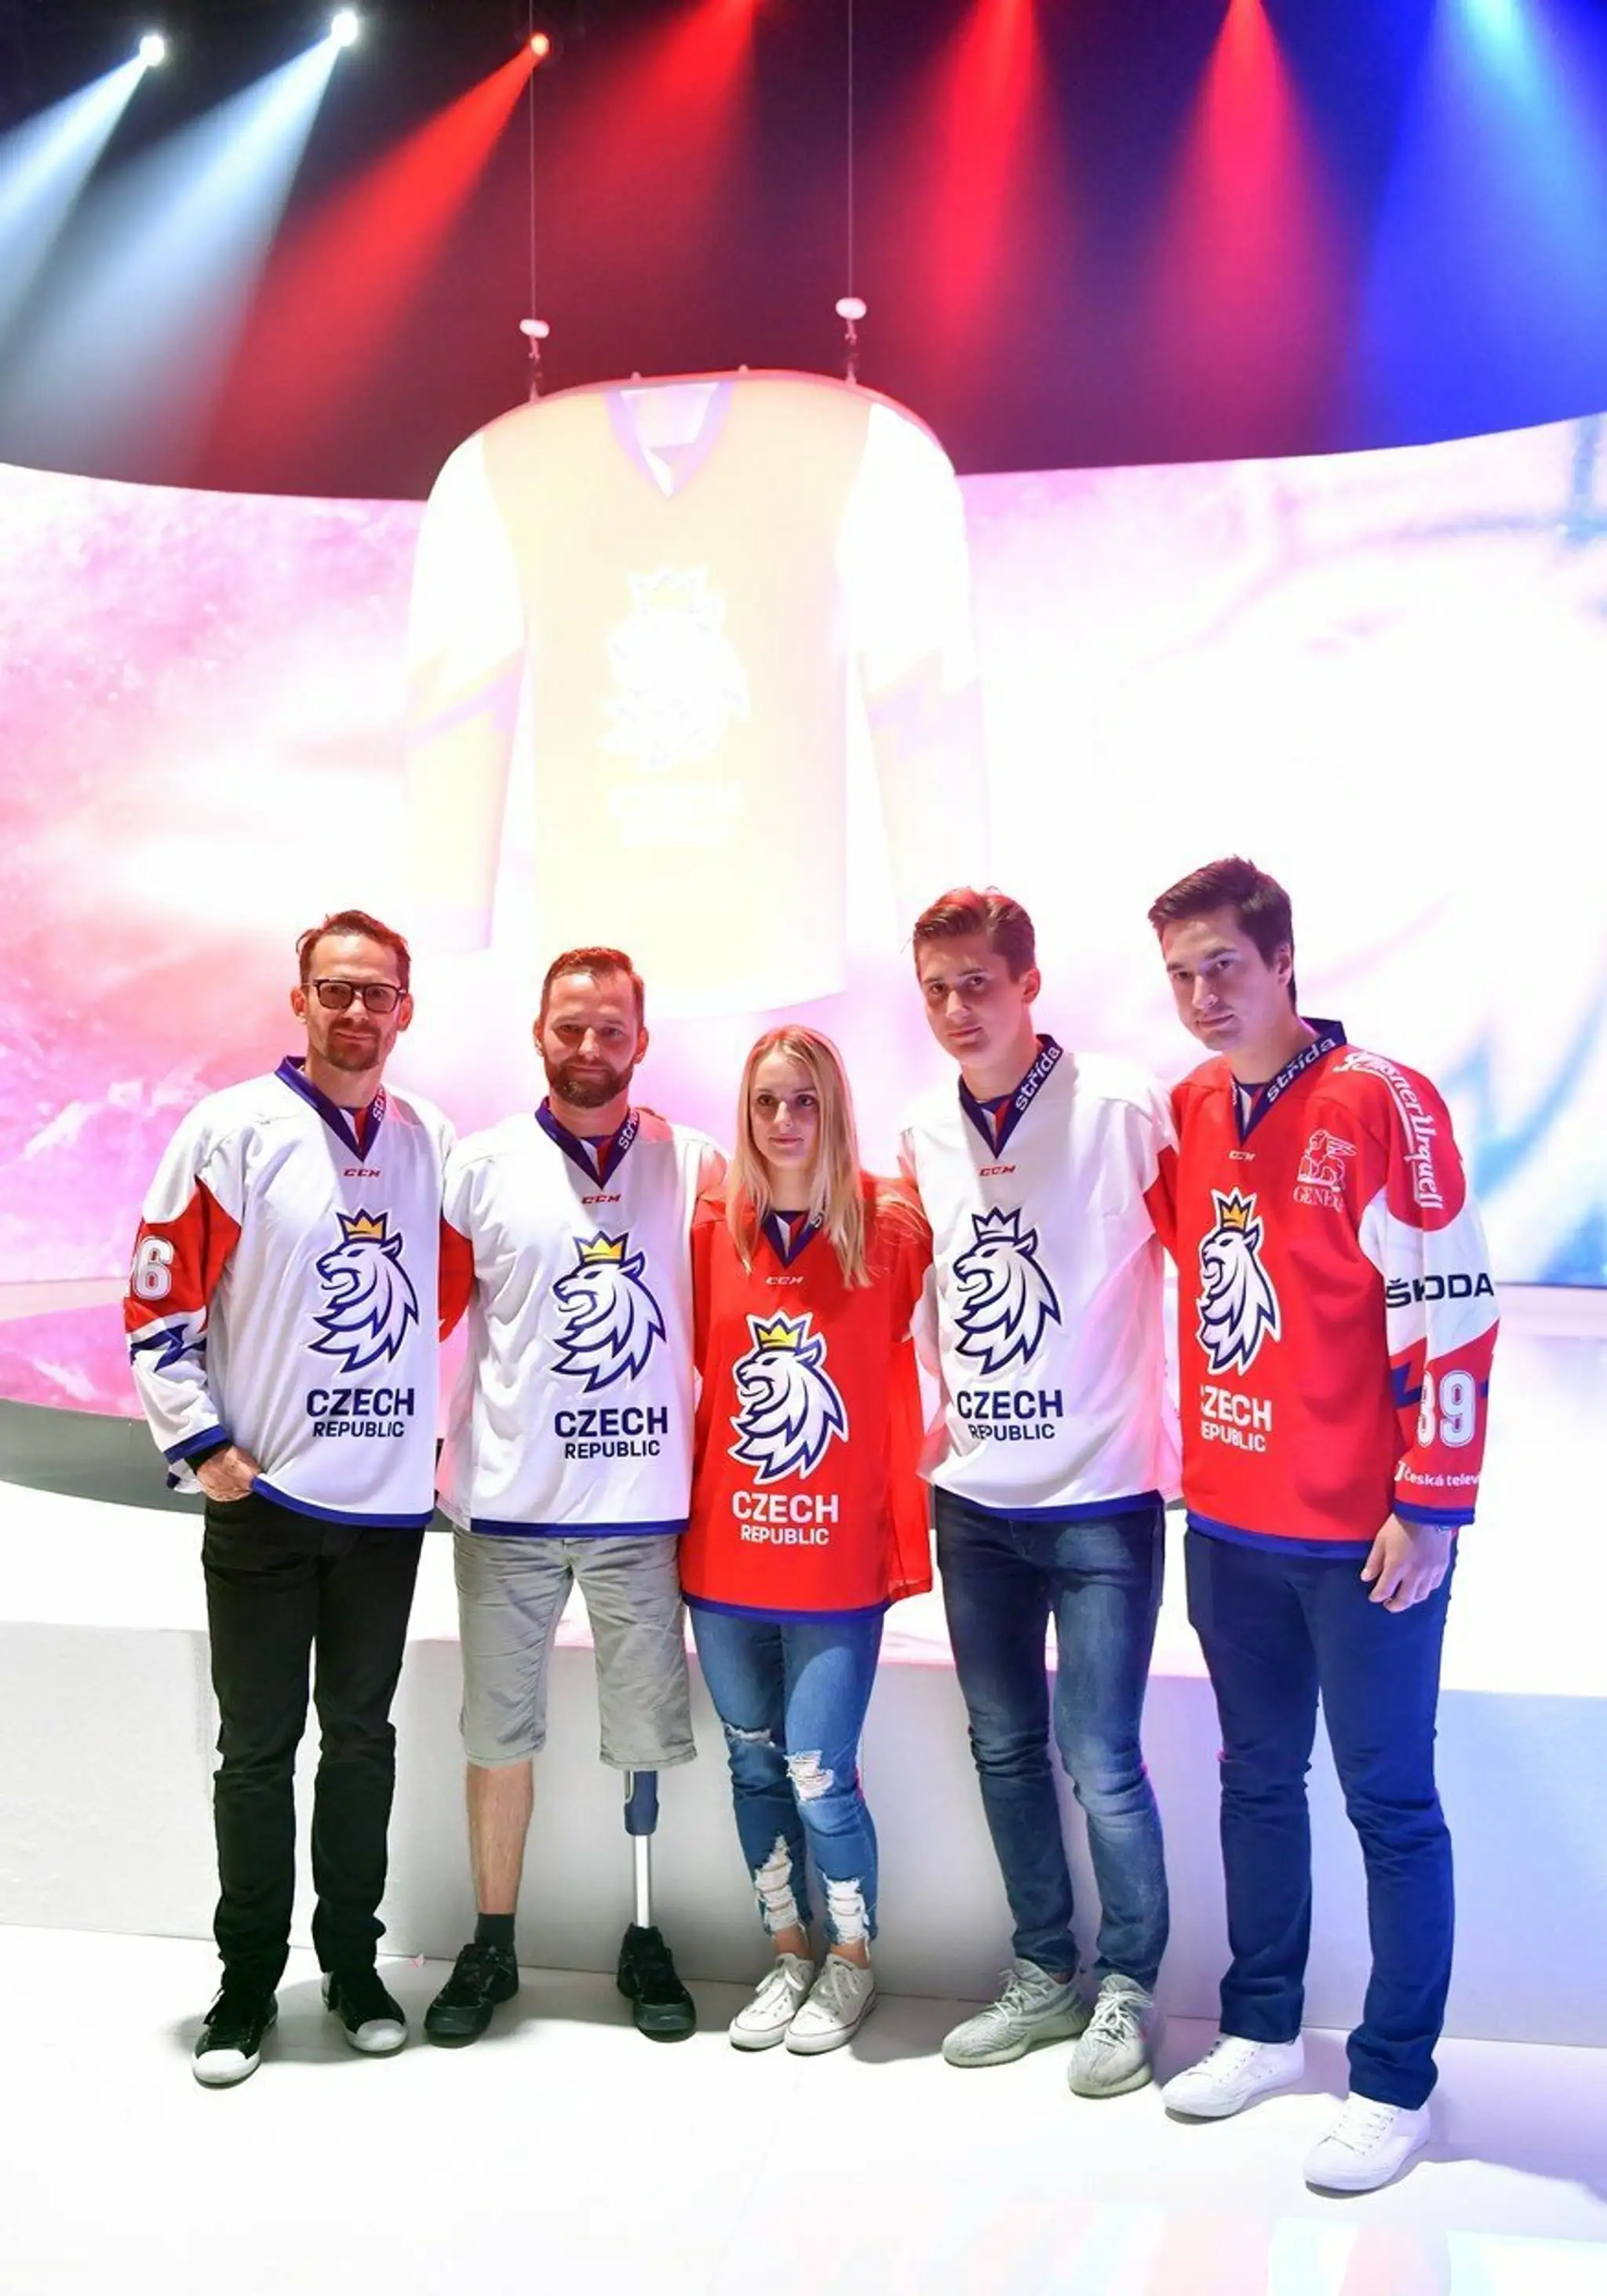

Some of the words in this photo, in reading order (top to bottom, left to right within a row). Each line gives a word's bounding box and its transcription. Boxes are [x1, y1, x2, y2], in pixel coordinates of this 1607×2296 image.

[344, 1168, 381, 1177] CCM
[978, 1164, 1016, 1177] CCM
[581, 1194, 621, 1204] CCM
[766, 1277, 804, 1285] CCM
[306, 1387, 415, 1417] CZECH
[957, 1389, 1064, 1420] CZECH
[312, 1420, 405, 1438] REPUBLIC
[554, 1406, 668, 1438] CZECH
[967, 1423, 1055, 1441] REPUBLIC
[1201, 1420, 1266, 1452] EPUBLIC
[564, 1439, 661, 1459] REPUBLIC
[732, 1490, 839, 1523] CZECH
[741, 1524, 829, 1545] REPUBLIC
